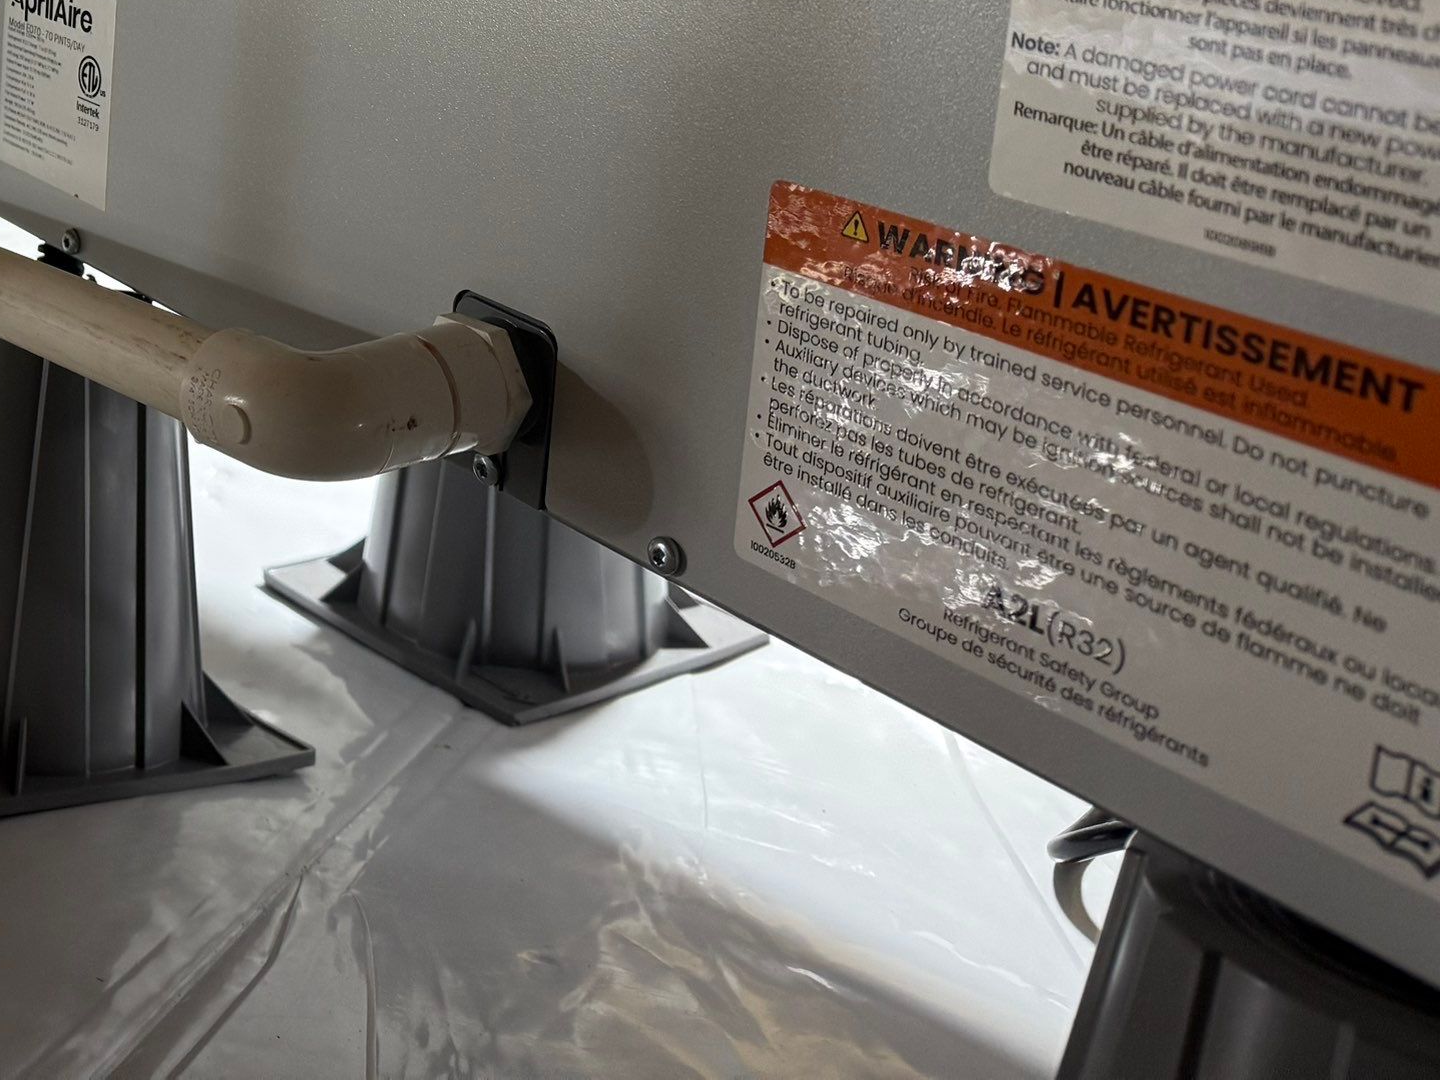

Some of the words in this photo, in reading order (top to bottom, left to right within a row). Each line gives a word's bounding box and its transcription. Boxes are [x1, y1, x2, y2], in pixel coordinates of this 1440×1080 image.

[9, 17, 25, 30] Model
[54, 33, 85, 53] PINTS/DAY
[1011, 31, 1060, 56] Note:
[1064, 42, 1077, 59] A
[1082, 45, 1184, 81] damaged
[1189, 70, 1255, 96] power
[1262, 85, 1315, 109] cord
[1187, 36, 1226, 55] sont
[76, 101, 99, 119] Intertek
[1027, 60, 1063, 79] and
[1069, 69, 1119, 91] must
[1123, 78, 1149, 98] be
[1156, 88, 1250, 120] replaced
[1096, 98, 1181, 129] supplied
[1187, 116, 1213, 142] by
[1219, 123, 1253, 146] the
[1014, 100, 1097, 134] Remarque:
[1102, 120, 1124, 140] Un
[1128, 128, 1173, 152] câble
[1178, 138, 1308, 184] d'alimentation
[1081, 137, 1112, 161] être
[1116, 147, 1171, 176] réparé.
[1064, 161, 1134, 190] nouveau
[1138, 178, 1183, 203] câble
[1187, 188, 1241, 218] fourni
[780, 303, 861, 341] refrigerant
[877, 219, 1045, 297] WARNG
[1072, 282, 1425, 412] AVERTISSEMENT
[1003, 317, 1018, 337] Le
[1006, 297, 1113, 346] Flammable
[1123, 334, 1241, 387] Refrigerant
[773, 357, 797, 378] the
[781, 279, 798, 299] To
[805, 288, 823, 307] be
[829, 300, 897, 333] repaired
[903, 326, 937, 352] only
[944, 336, 964, 361] by
[971, 346, 1035, 382] trained
[1042, 374, 1109, 408] service
[1235, 436, 1263, 462] Do
[1272, 454, 1307, 478] not
[1317, 469, 1428, 520] puncture
[769, 398, 831, 432] perforez
[836, 425, 865, 446] pas
[871, 435, 892, 458] les
[899, 447, 945, 479] tubes
[951, 467, 973, 490] de
[775, 337, 837, 378] Auxiliary
[843, 362, 904, 399] devices
[911, 392, 960, 420] which
[967, 413, 1007, 443] may
[1013, 426, 1036, 449] be
[1210, 504, 1261, 535] shall
[1269, 526, 1303, 551] not
[777, 318, 837, 353] Dispose
[843, 345, 858, 361] of
[863, 354, 932, 393] properly
[959, 388, 1071, 440] accordance
[1206, 479, 1227, 498] or
[1236, 485, 1290, 521] local
[763, 451, 792, 476] être
[797, 466, 851, 501] installé
[856, 490, 896, 521] dans
[902, 510, 923, 533] les
[767, 410, 826, 450] Éliminer
[831, 438, 843, 457] le
[849, 448, 935, 496] réfrigérant
[941, 488, 962, 507] en
[968, 499, 1069, 552] respectant
[1075, 538, 1100, 565] les
[1108, 555, 1226, 618] règlements
[772, 376, 794, 397] Les
[799, 389, 890, 436] réparations
[897, 425, 959, 463] doivent
[966, 452, 999, 479] être
[1152, 529, 1177, 550] un
[1184, 542, 1248, 579] agent
[766, 431, 798, 458] Tout
[802, 447, 872, 490] dispositif
[877, 482, 949, 523] auxiliaire
[955, 515, 1030, 557] pouvant
[1037, 546, 1074, 576] être
[1081, 568, 1117, 595] une
[1125, 587, 1195, 628] source
[1202, 615, 1229, 643] de
[898, 606, 956, 646] Groupe
[961, 636, 981, 658] de
[987, 651, 1054, 693] sécurité
[1060, 683, 1092, 711] des
[1098, 704, 1207, 766] réfrigérants
[943, 605, 1034, 661] Refrigerant
[1039, 650, 1097, 695] Safety
[1100, 678, 1158, 724] Group
